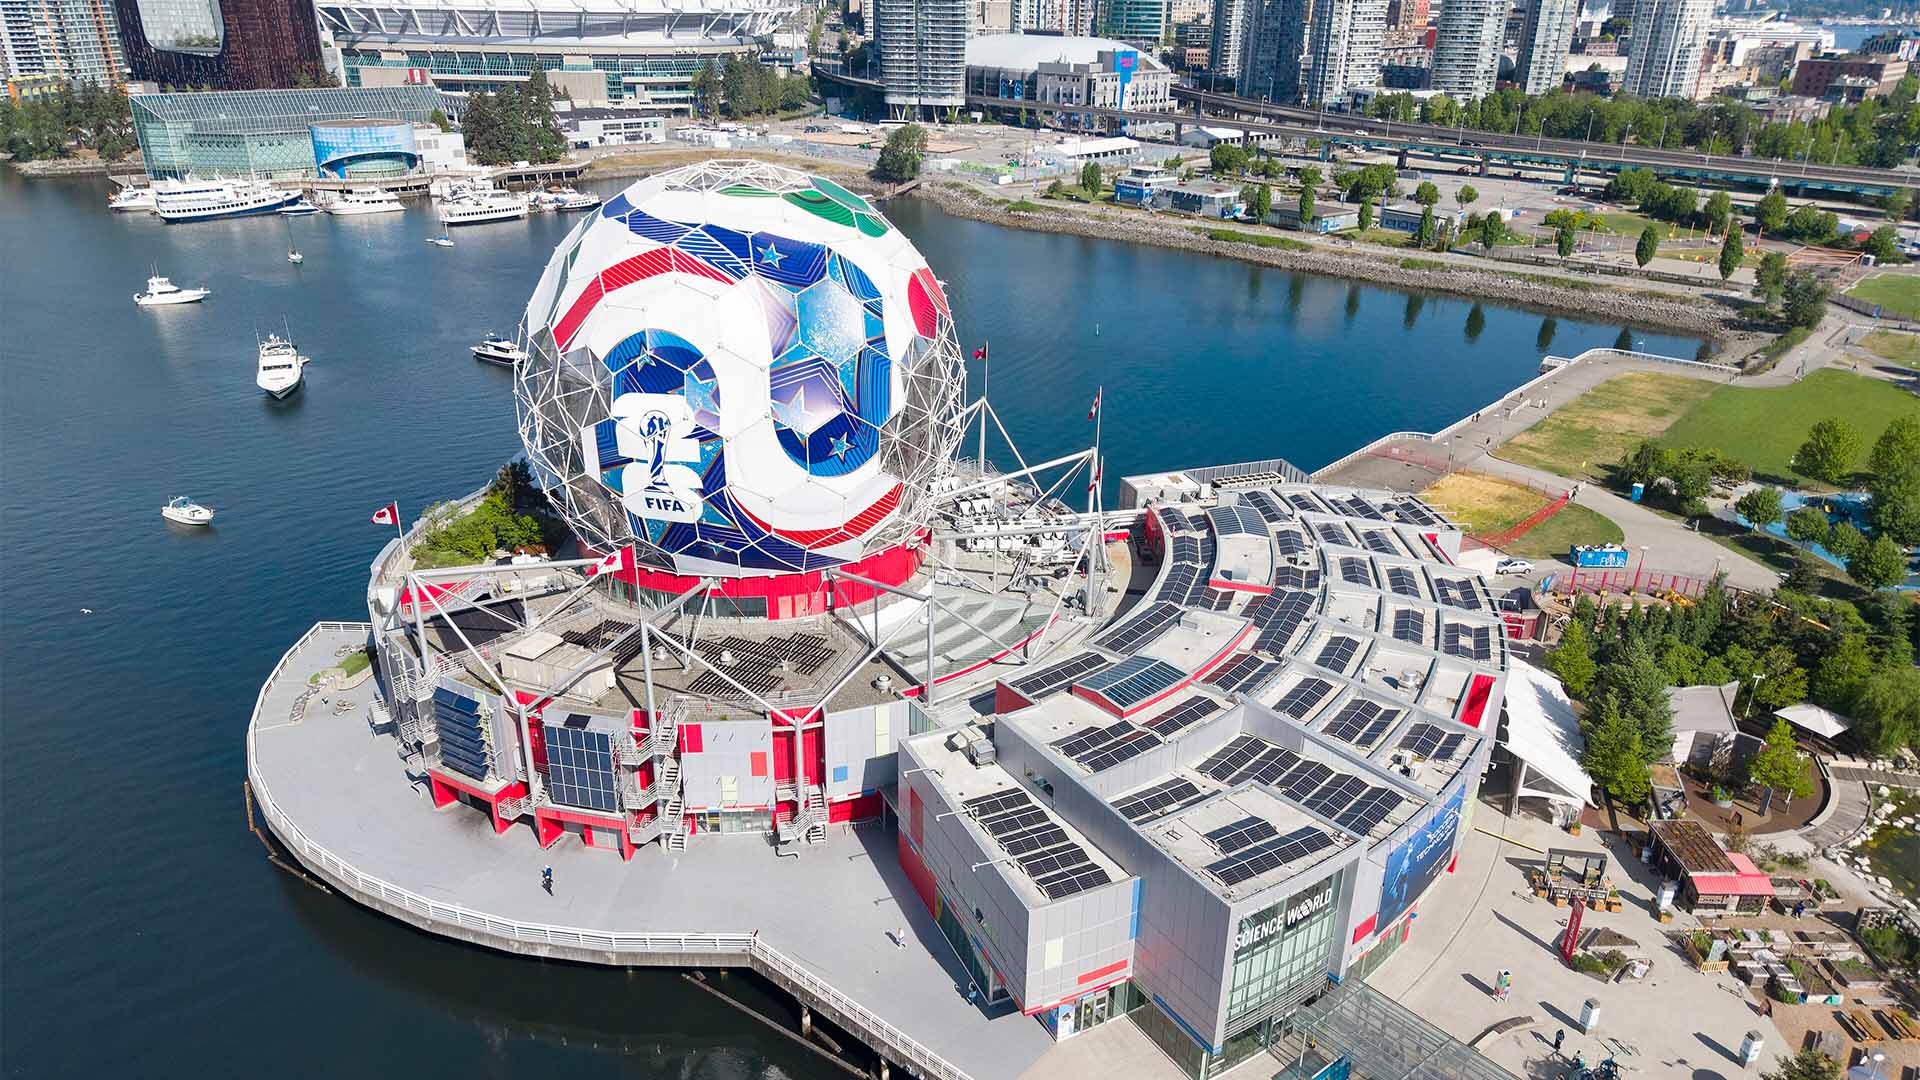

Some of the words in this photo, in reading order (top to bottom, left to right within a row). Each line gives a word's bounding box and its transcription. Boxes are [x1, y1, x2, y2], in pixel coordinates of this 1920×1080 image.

[645, 497, 685, 512] FIFA
[1234, 913, 1285, 951] SCIENCE
[1287, 888, 1333, 926] WORLD
